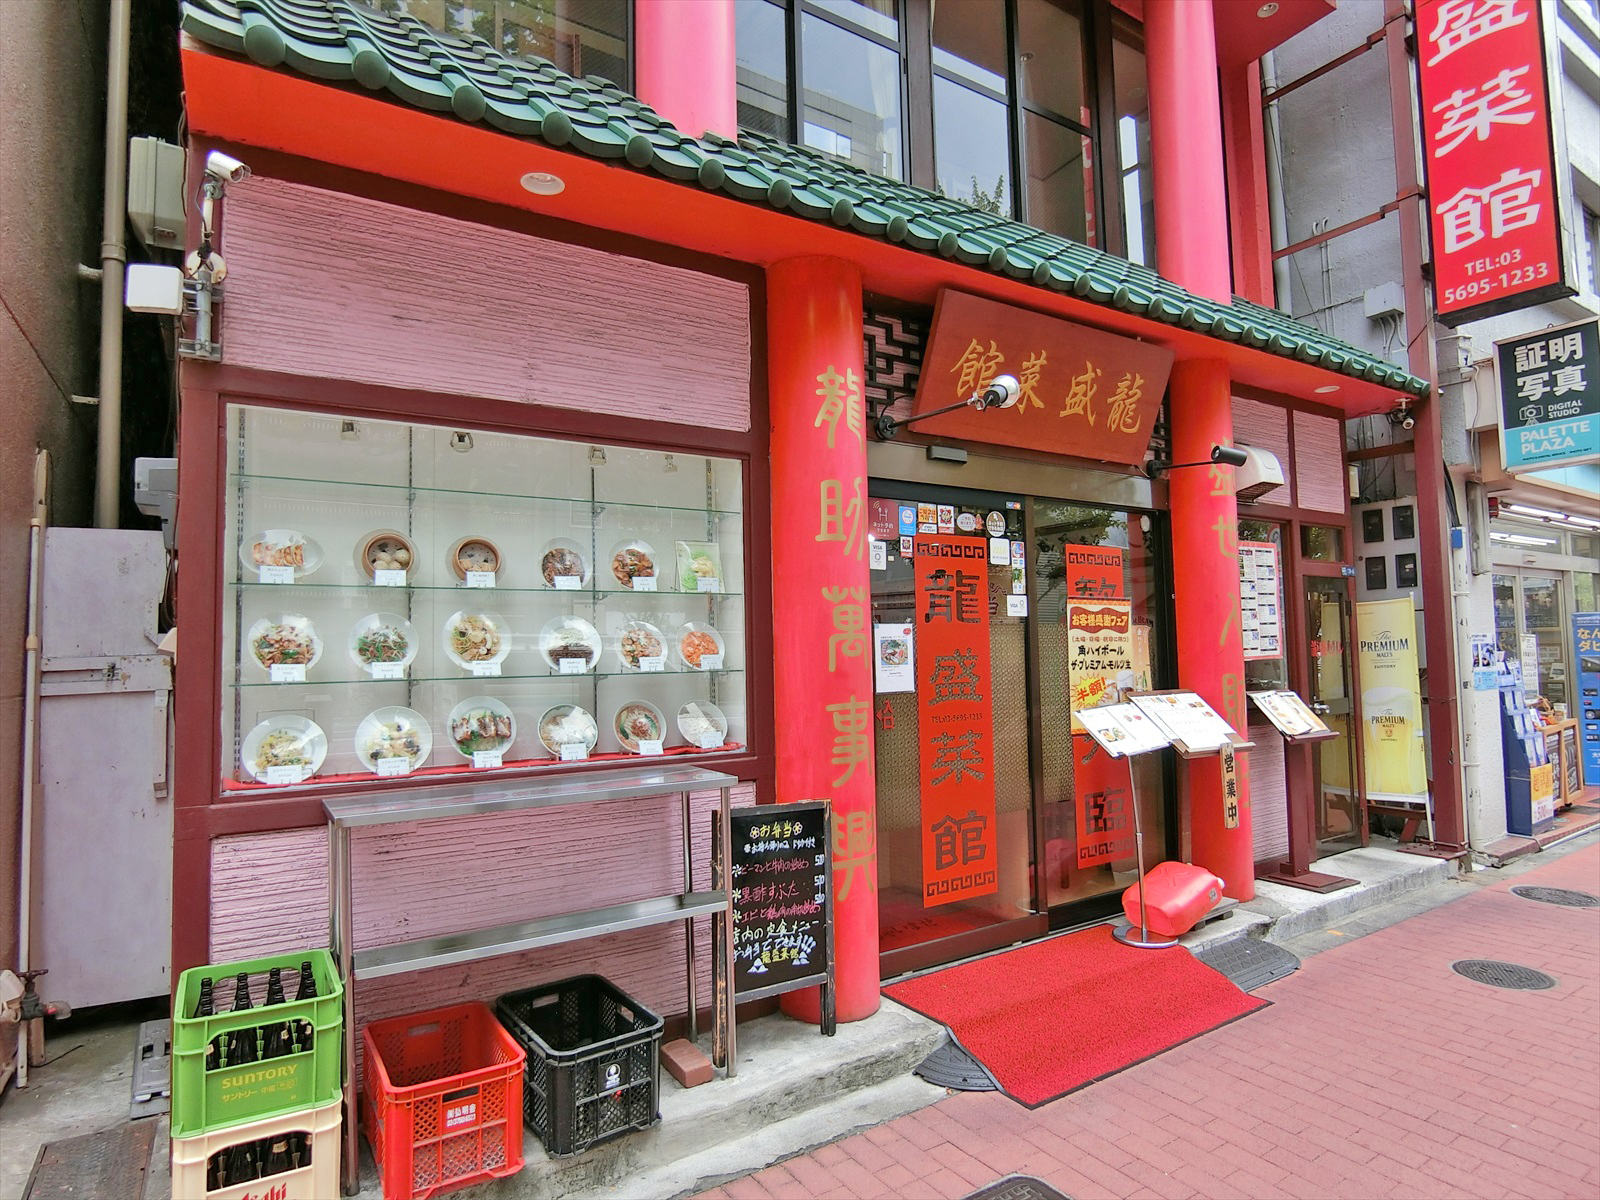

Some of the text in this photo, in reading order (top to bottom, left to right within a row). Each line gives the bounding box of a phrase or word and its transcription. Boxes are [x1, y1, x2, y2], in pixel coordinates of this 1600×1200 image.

[1464, 248, 1522, 276] TEL:03
[1444, 262, 1549, 305] 5695-1233
[1513, 332, 1584, 374] 証明
[1517, 364, 1588, 402] 写真
[1547, 399, 1583, 412] DIGITAL
[1548, 407, 1580, 420] STUDIO
[1520, 420, 1591, 443] PALETTE
[1521, 436, 1575, 455] PLAZA
[1071, 613, 1128, 628] お客様感謝フェア
[1077, 645, 1125, 657] 角ハイボール
[1360, 638, 1409, 653] PREMIUM
[883, 699, 895, 730] 入口
[1371, 715, 1406, 725] PREMIUM
[1224, 753, 1238, 822] 営業中
[759, 820, 792, 838] お弁当
[222, 1063, 298, 1089] SUNTORY
[222, 1089, 258, 1102] サントリー
